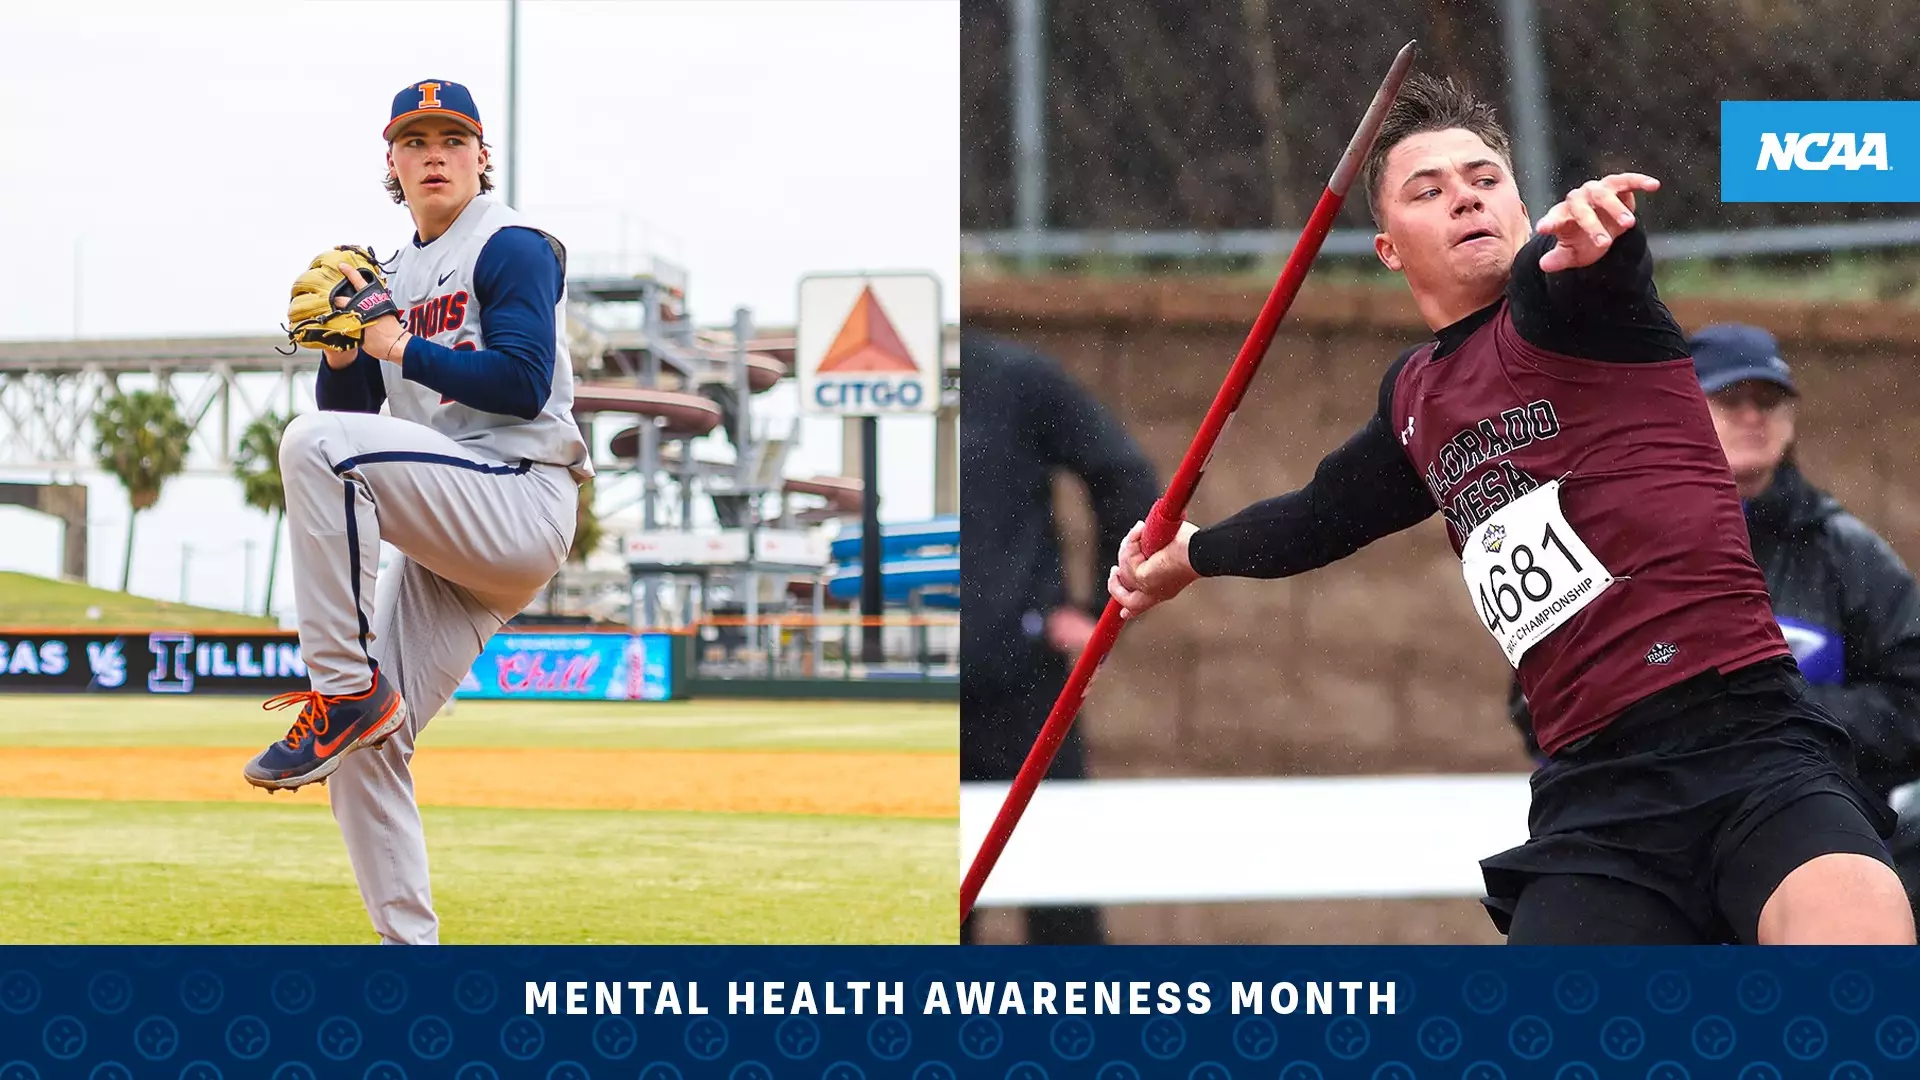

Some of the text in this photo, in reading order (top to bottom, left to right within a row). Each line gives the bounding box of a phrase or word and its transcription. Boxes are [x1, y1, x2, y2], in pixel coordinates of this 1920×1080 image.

[419, 82, 441, 109] I
[815, 381, 923, 407] CITGO
[1443, 459, 1539, 547] MESA
[1479, 522, 1583, 635] 4681
[1516, 577, 1593, 640] CHAMPIONSHIP
[496, 652, 600, 692] Chill
[1647, 645, 1676, 663] RMAC
